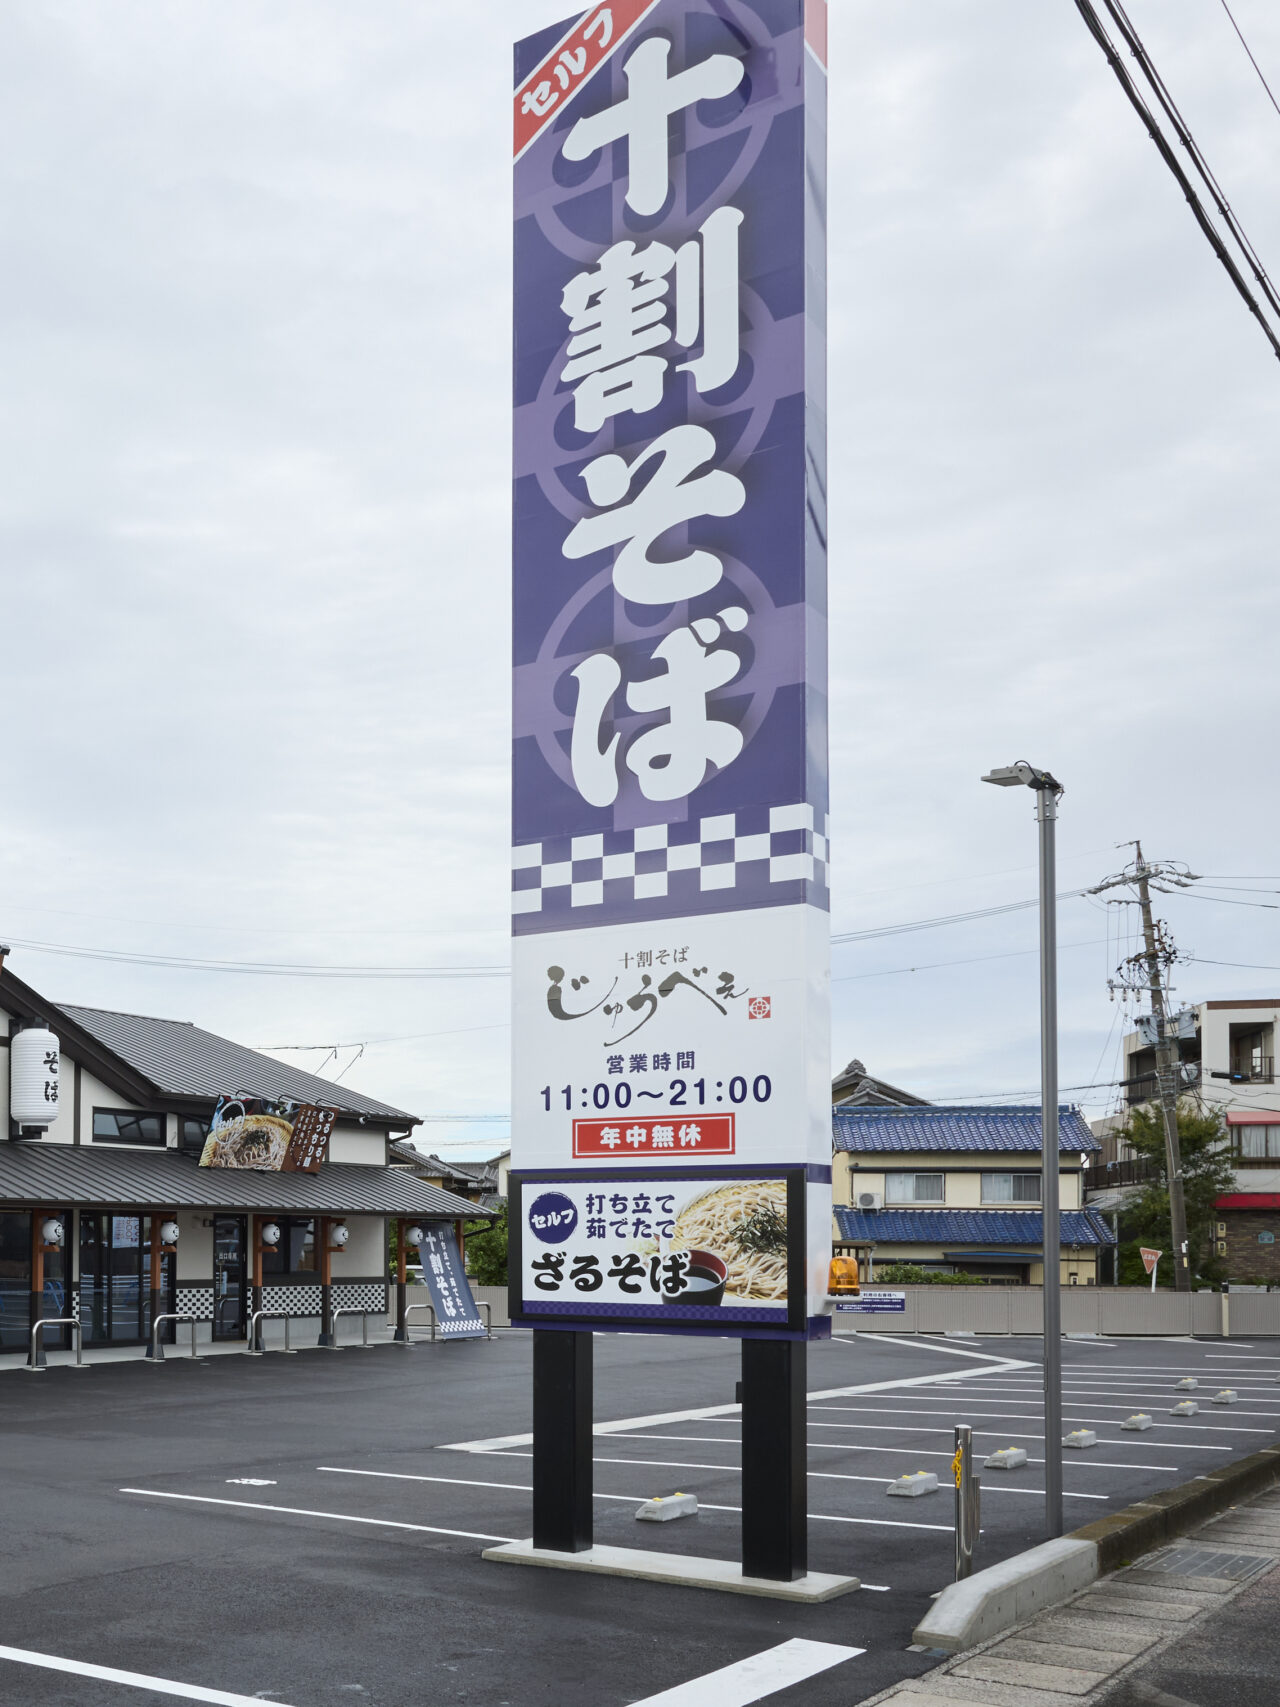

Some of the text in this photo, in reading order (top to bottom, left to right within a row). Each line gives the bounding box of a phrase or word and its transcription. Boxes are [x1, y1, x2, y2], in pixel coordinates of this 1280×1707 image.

[521, 8, 614, 117] セルフ
[561, 36, 749, 808] 十割そば
[618, 945, 690, 969] 十割そば
[606, 1050, 696, 1075] 営業時間
[42, 1050, 60, 1103] そば
[599, 1122, 702, 1149] 年中無休
[585, 1193, 675, 1214] 打ち立て
[531, 1207, 575, 1230] セルフ
[585, 1217, 676, 1239] 茹でたて
[530, 1250, 691, 1294] ざるそば
